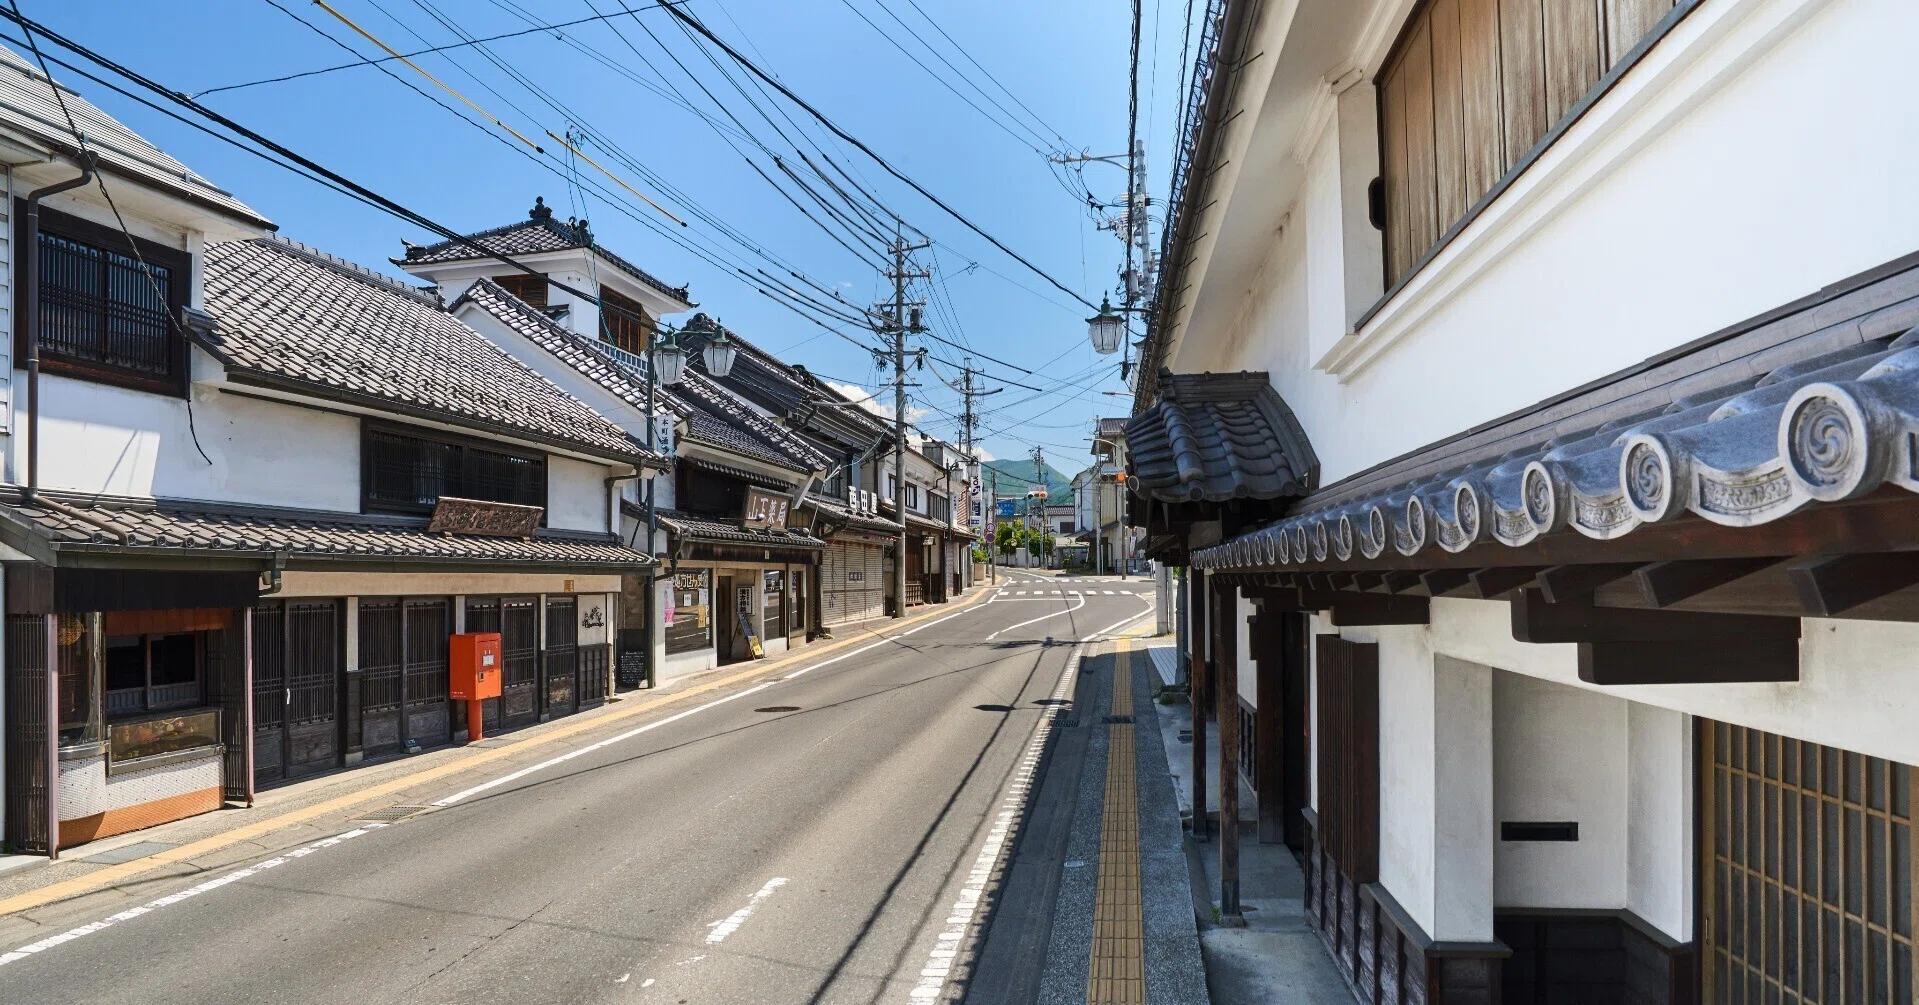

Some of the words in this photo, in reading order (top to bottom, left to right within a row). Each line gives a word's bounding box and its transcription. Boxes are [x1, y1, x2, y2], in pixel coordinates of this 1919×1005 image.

[660, 418, 670, 455] 本町通り
[747, 495, 787, 527] 山下薬局
